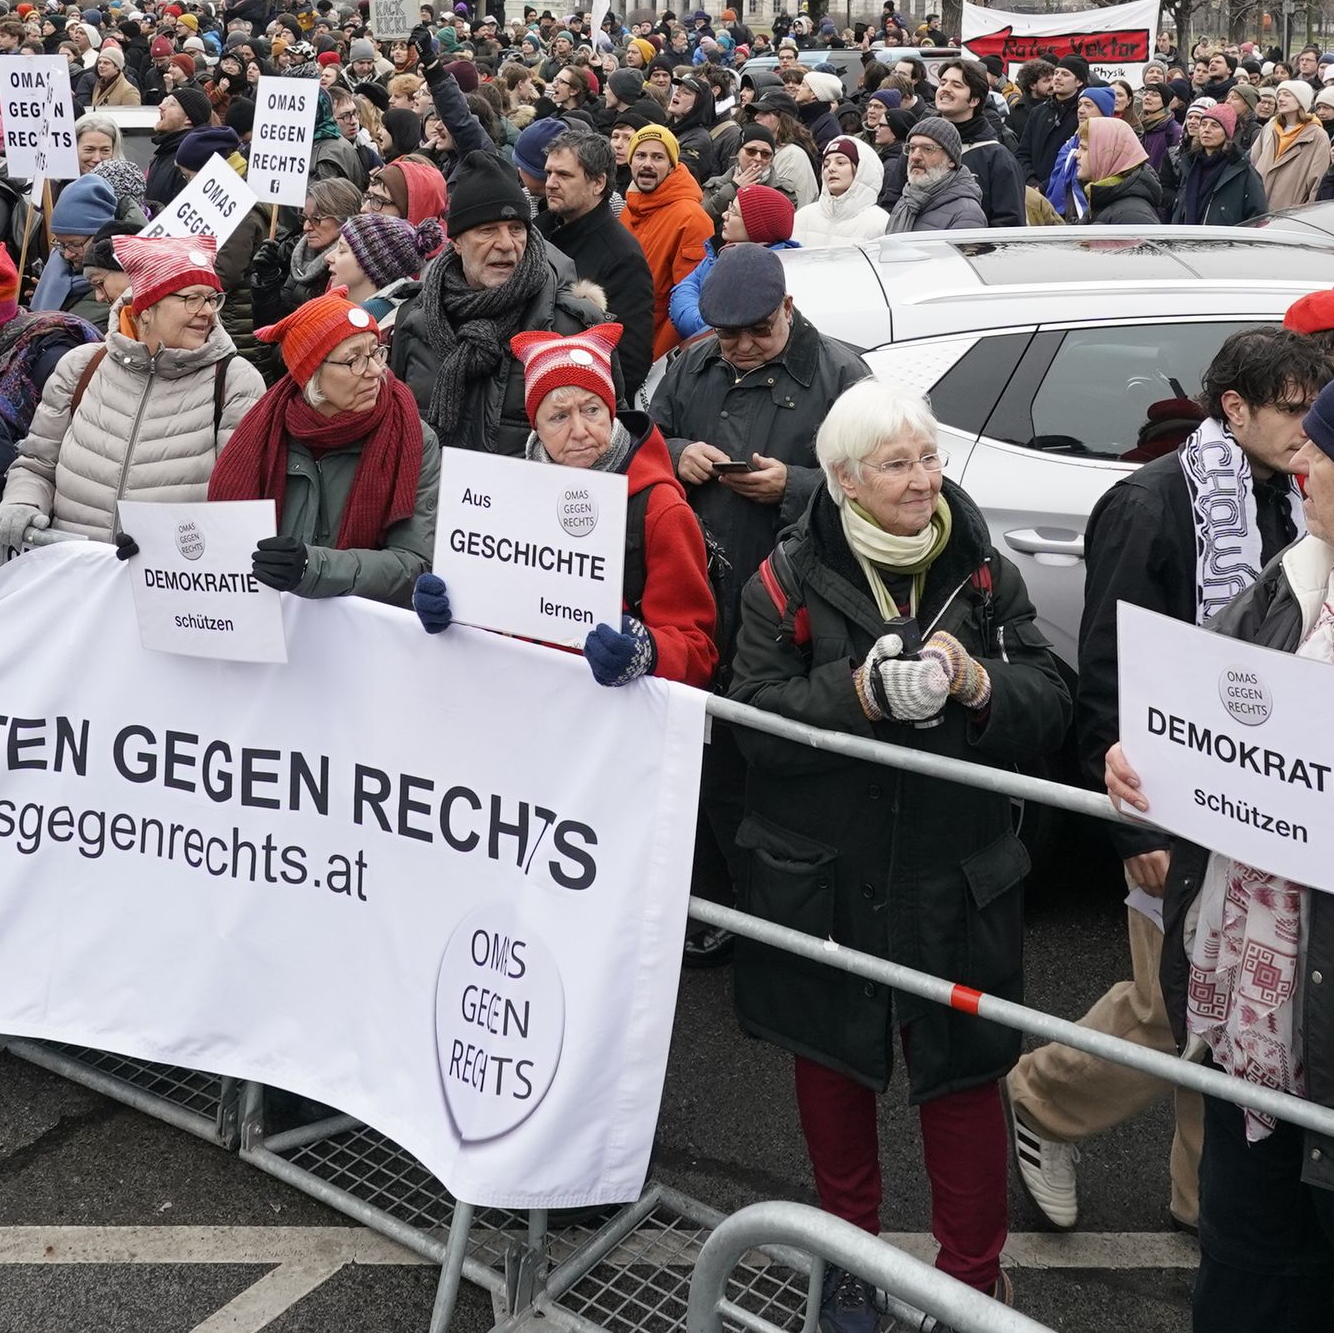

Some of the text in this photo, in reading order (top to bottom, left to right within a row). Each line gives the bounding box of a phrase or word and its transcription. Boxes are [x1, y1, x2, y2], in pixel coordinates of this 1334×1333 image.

[1093, 66, 1126, 79] Physik
[9, 102, 64, 117] GEGN
[267, 93, 306, 112] OMAS
[8, 131, 72, 147] RECTS
[260, 123, 306, 143] GEGEN
[252, 153, 306, 174] RECHTS
[202, 178, 237, 217] OMAS
[176, 202, 218, 237] GEGE
[462, 487, 492, 509] Aus
[565, 489, 589, 501] OMAS
[563, 503, 592, 514] GEGEN
[563, 516, 594, 527] RECHTS
[449, 528, 606, 582] GESCHICHTE
[144, 568, 260, 594] DEMOKRATIE
[539, 596, 594, 624] lernen
[174, 610, 235, 633] schützen
[1226, 670, 1258, 685] OMAS
[1227, 686, 1263, 700] GEGEN
[1227, 700, 1268, 717] RECHTS
[112, 723, 330, 816] GEGEN
[352, 762, 599, 891] RECHTS
[1193, 787, 1308, 844] schützen
